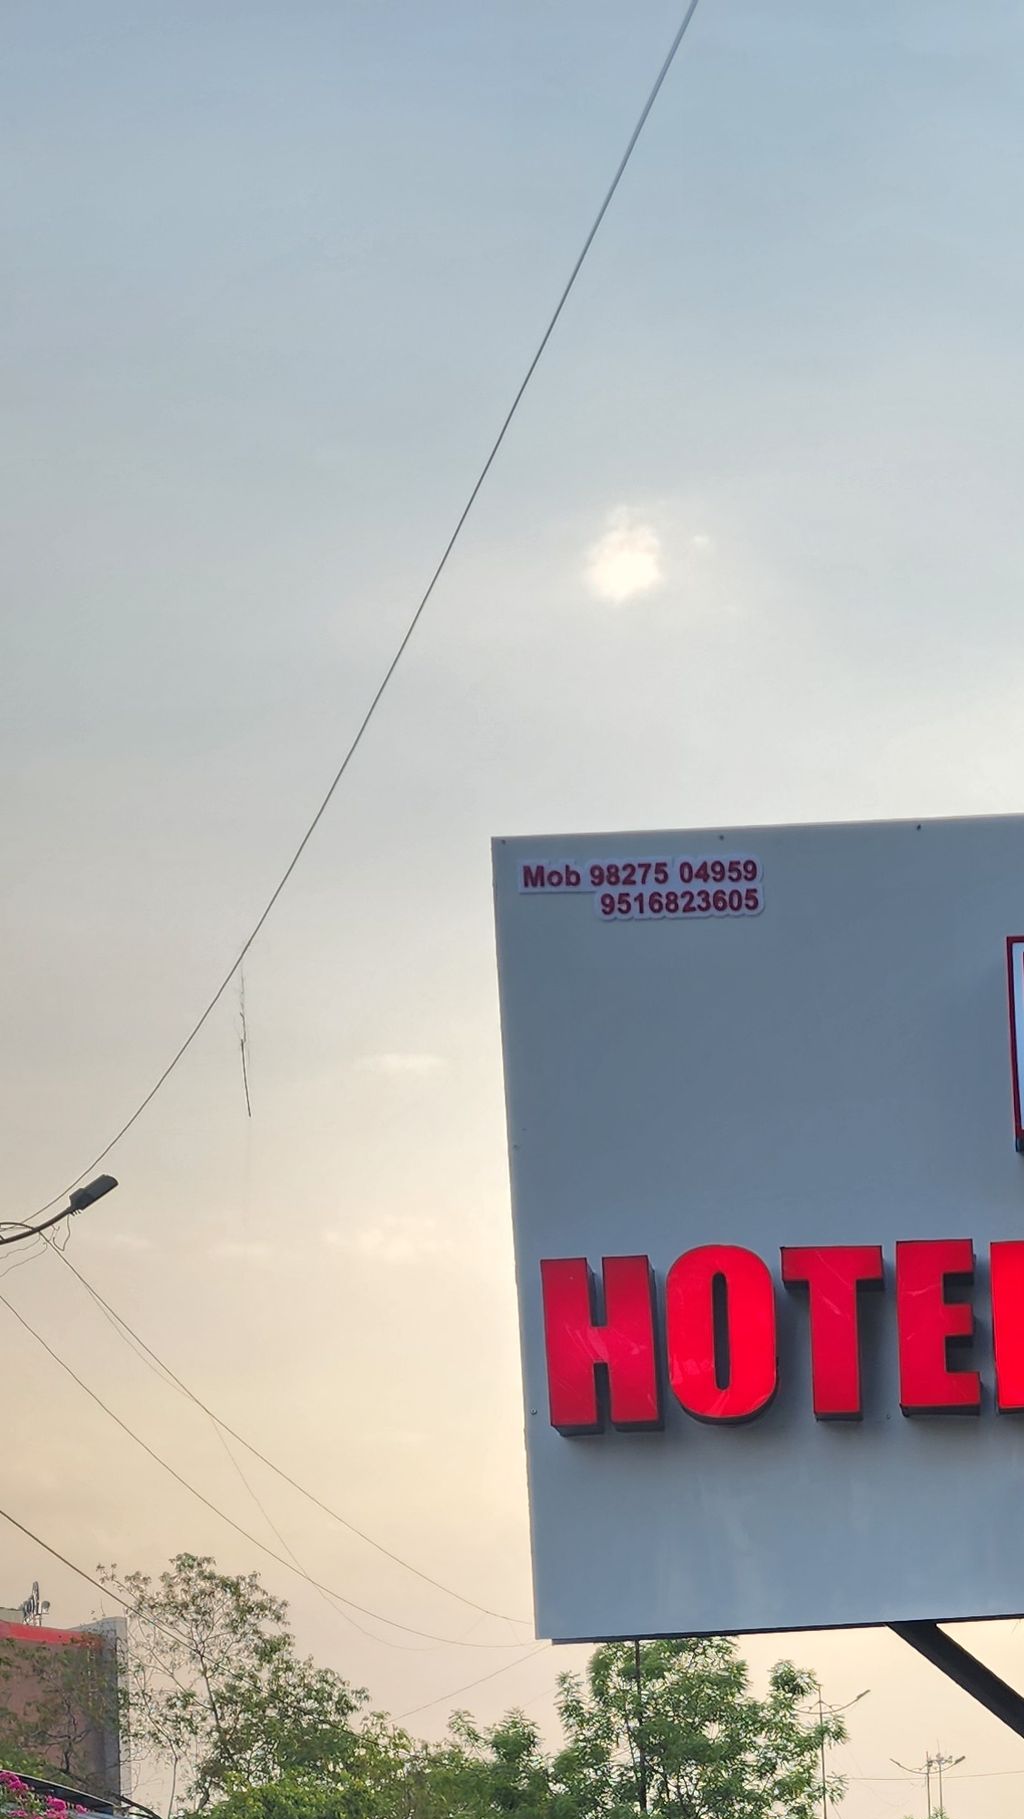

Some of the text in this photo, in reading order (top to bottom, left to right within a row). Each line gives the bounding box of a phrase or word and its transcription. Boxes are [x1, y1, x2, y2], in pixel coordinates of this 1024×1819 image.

[522, 859, 758, 888] Mob 98275 04959
[600, 888, 760, 916] 9516823605
